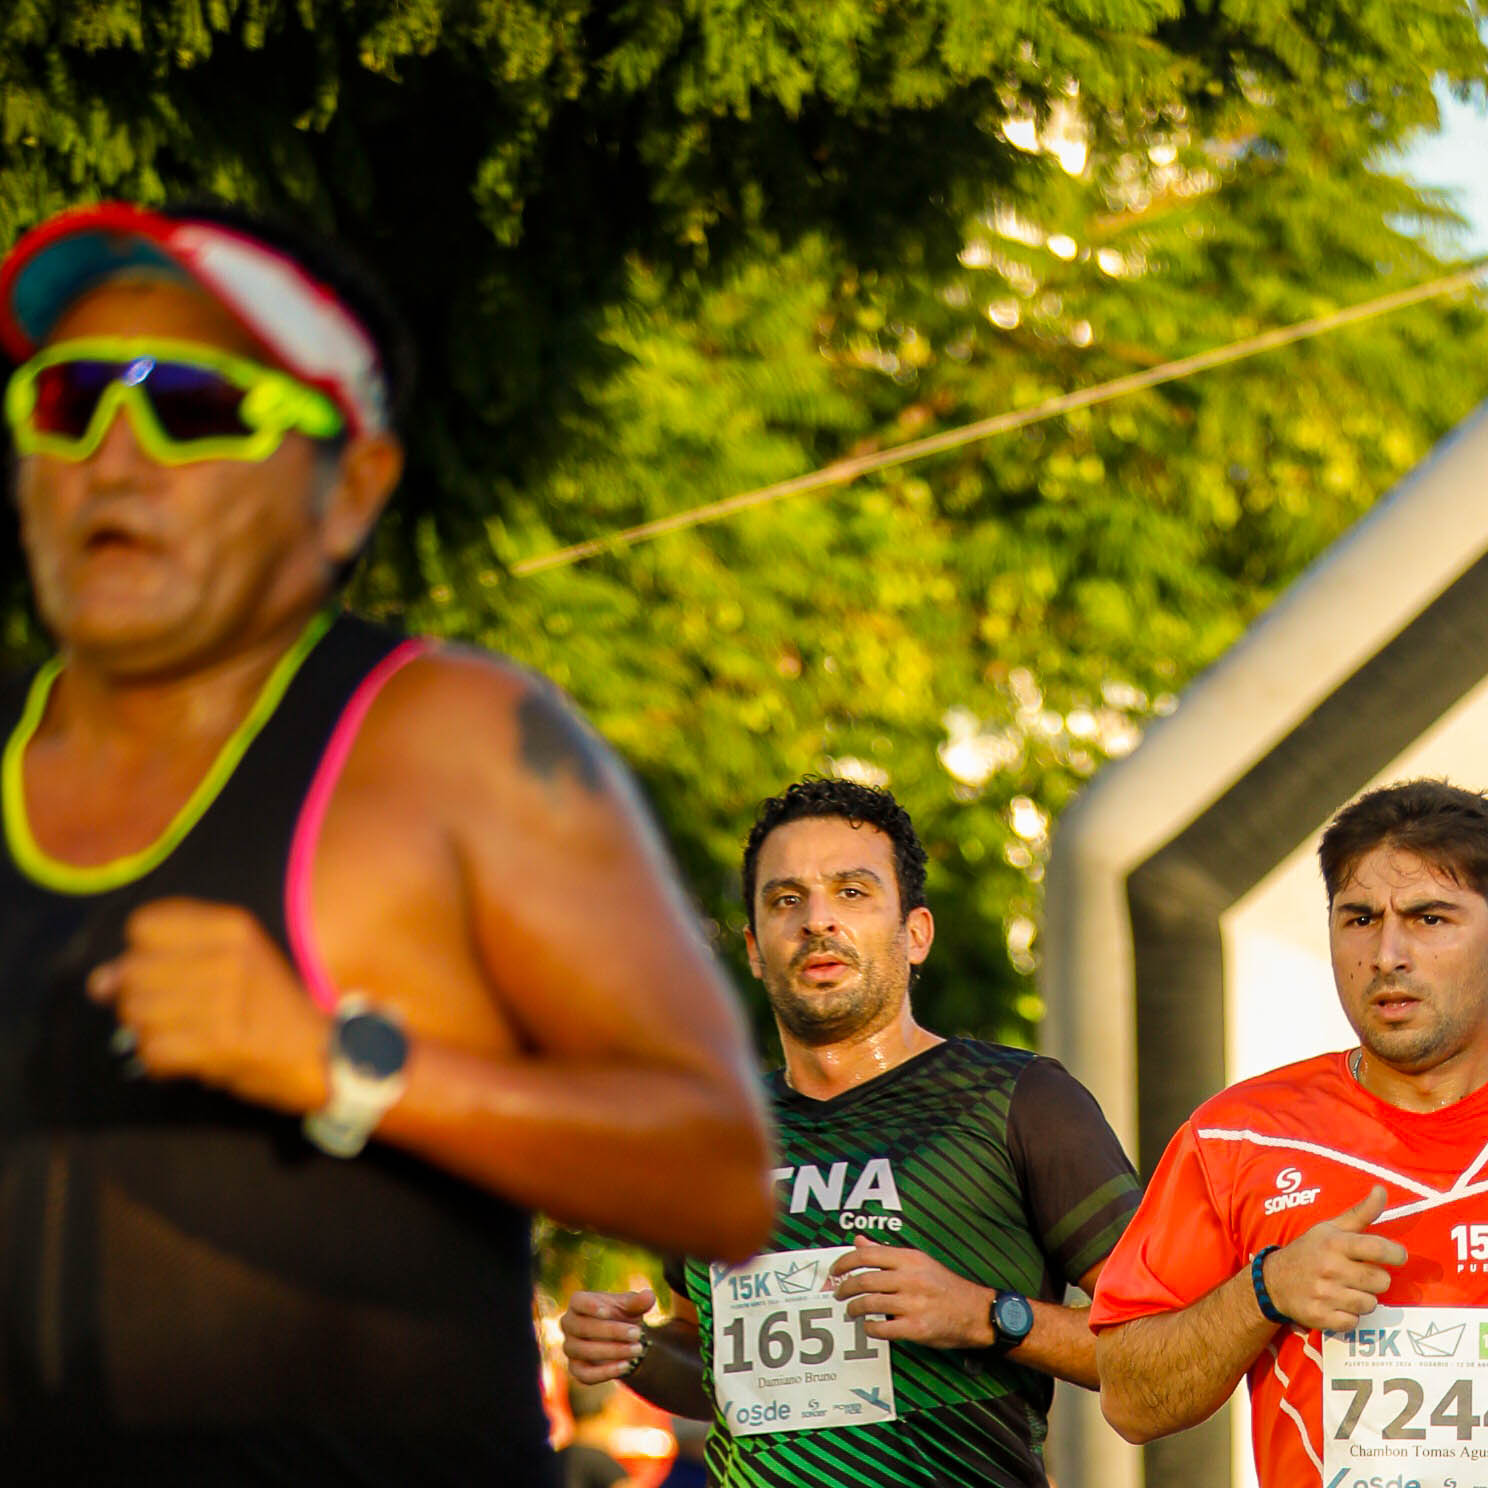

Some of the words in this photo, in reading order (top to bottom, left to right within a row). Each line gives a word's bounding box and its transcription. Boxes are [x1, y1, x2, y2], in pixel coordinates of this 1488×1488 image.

[839, 1212, 903, 1231] Corre
[728, 1272, 772, 1301] 15K
[722, 1307, 879, 1374] 1651
[1344, 1329, 1402, 1358] 15K
[804, 1372, 837, 1384] Bruno
[736, 1400, 791, 1426] osde
[1350, 1444, 1408, 1458] Chambon
[1413, 1445, 1456, 1458] Tomas
